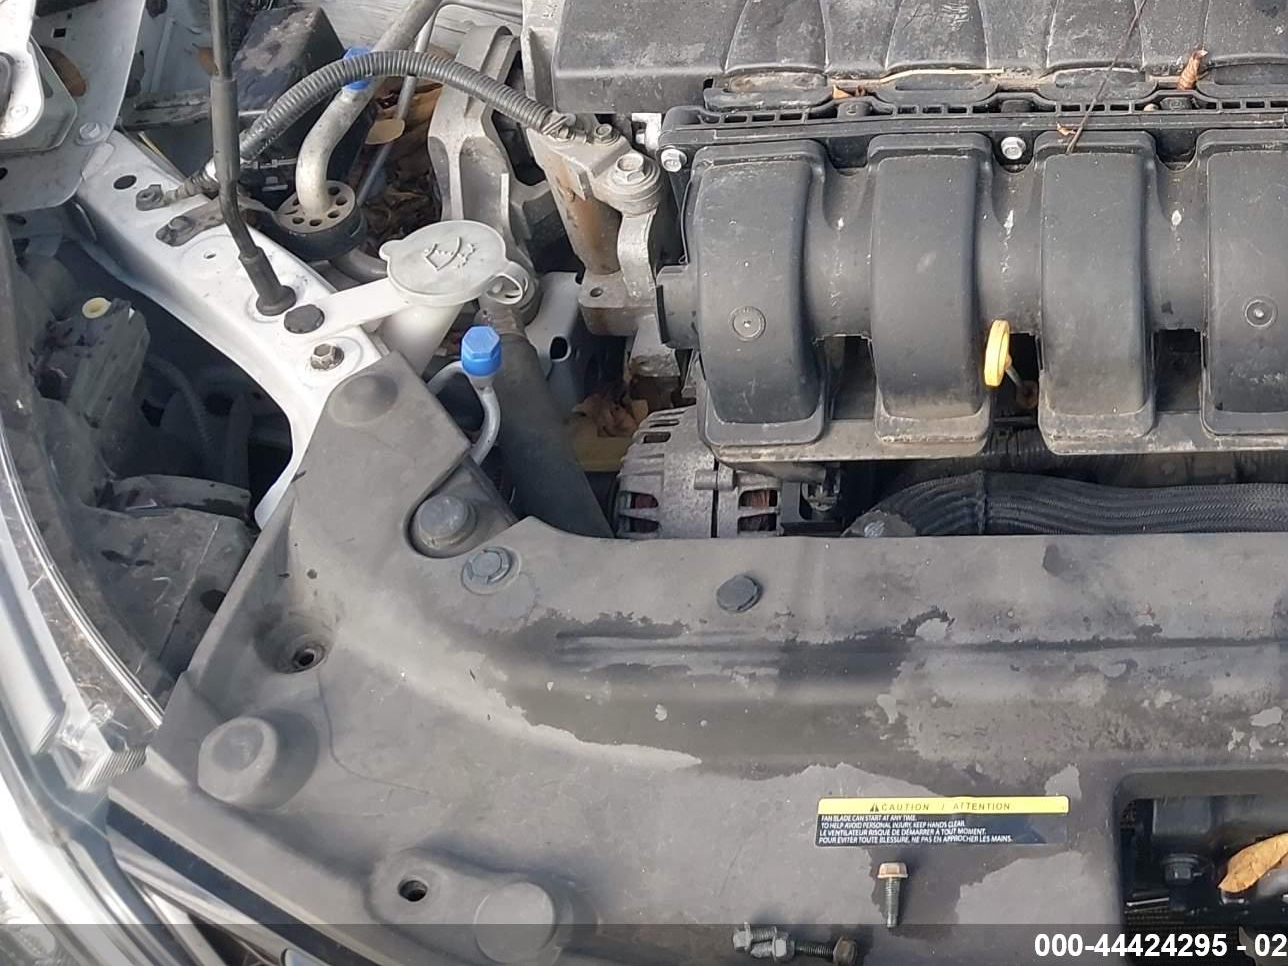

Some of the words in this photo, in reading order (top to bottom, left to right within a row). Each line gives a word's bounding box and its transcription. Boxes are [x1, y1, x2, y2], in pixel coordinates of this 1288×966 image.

[881, 803, 929, 811] CAUTION
[952, 802, 1010, 811] ATTENTION
[821, 814, 833, 822] FAN
[833, 814, 851, 822] BLADE
[852, 814, 864, 822] CAN
[865, 814, 881, 822] START
[882, 814, 890, 822] AT
[890, 814, 902, 822] ANY
[822, 822, 829, 830] TO
[913, 821, 926, 829] KEEP
[928, 821, 947, 829] HANDS
[820, 829, 827, 837] LE
[828, 829, 868, 837] VENTILATEUR
[941, 828, 956, 836] TOUT
[819, 836, 837, 844] POUR
[859, 836, 878, 844] TOUTE
[933, 835, 942, 843] EN
[943, 834, 978, 843] APPROCHER
[980, 835, 990, 843] LES
